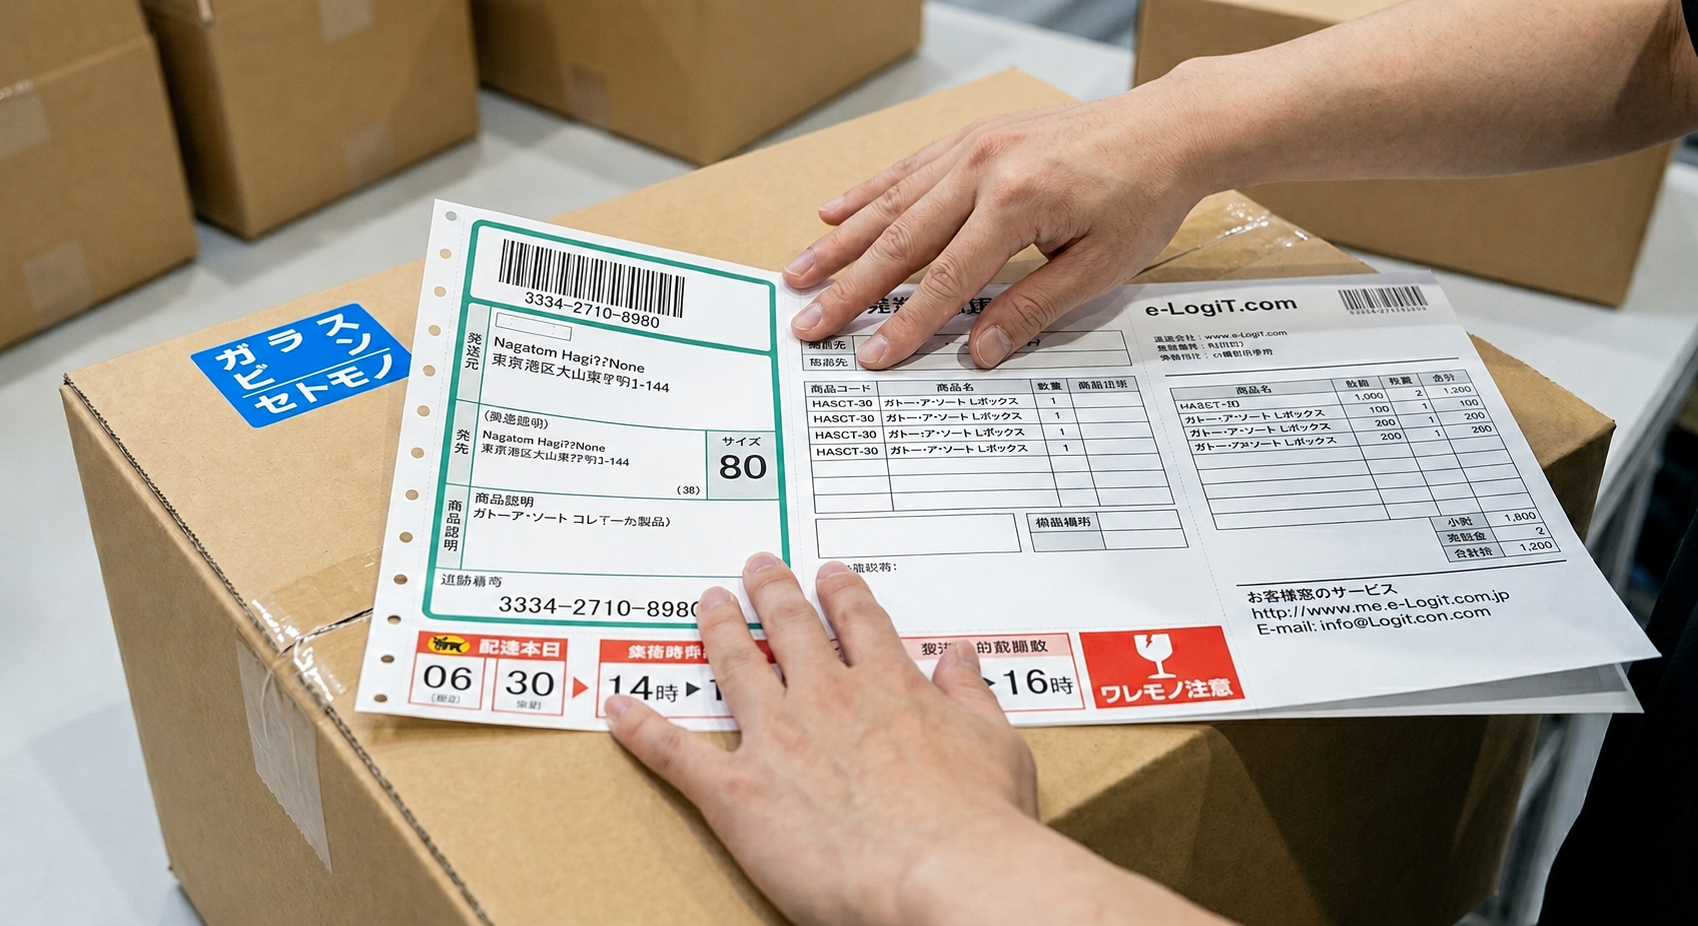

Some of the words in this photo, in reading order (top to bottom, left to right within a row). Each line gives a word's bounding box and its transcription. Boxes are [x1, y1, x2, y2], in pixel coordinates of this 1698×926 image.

[524, 291, 660, 328] 3334-2710-8980
[1145, 299, 1298, 317] e-LogiT.com
[215, 313, 360, 371] ガラス
[254, 353, 393, 414] セトモノ
[811, 384, 871, 394] 商品コード
[936, 383, 974, 393] 商品名
[1236, 385, 1272, 395] 商品名
[1354, 392, 1384, 401] 1,000
[1415, 389, 1423, 397] 2
[1443, 385, 1472, 395] 1,200
[812, 399, 873, 408] HASCT-30
[1369, 405, 1390, 414] 100
[1460, 399, 1479, 407] 100
[813, 415, 875, 423] HASCT-30
[1375, 418, 1396, 427] 200
[1464, 412, 1486, 420] 200
[722, 436, 761, 447] サイズ
[815, 430, 877, 440] HASCT-30
[1380, 431, 1402, 441] 200
[816, 447, 879, 456] HASCT-30
[719, 454, 767, 480] 80
[677, 485, 701, 496] (38)
[1504, 511, 1537, 523] 1,800
[1535, 526, 1545, 535] 2
[1519, 541, 1553, 552] 1,200
[1252, 589, 1510, 621] http://www.me.e-Logit.com.jp
[1256, 622, 1317, 636] E-mail:
[1320, 605, 1491, 631] info@Logit.con.com
[423, 664, 473, 691] 06
[505, 670, 554, 697] 30
[1100, 677, 1234, 704] ワレモノ注意
